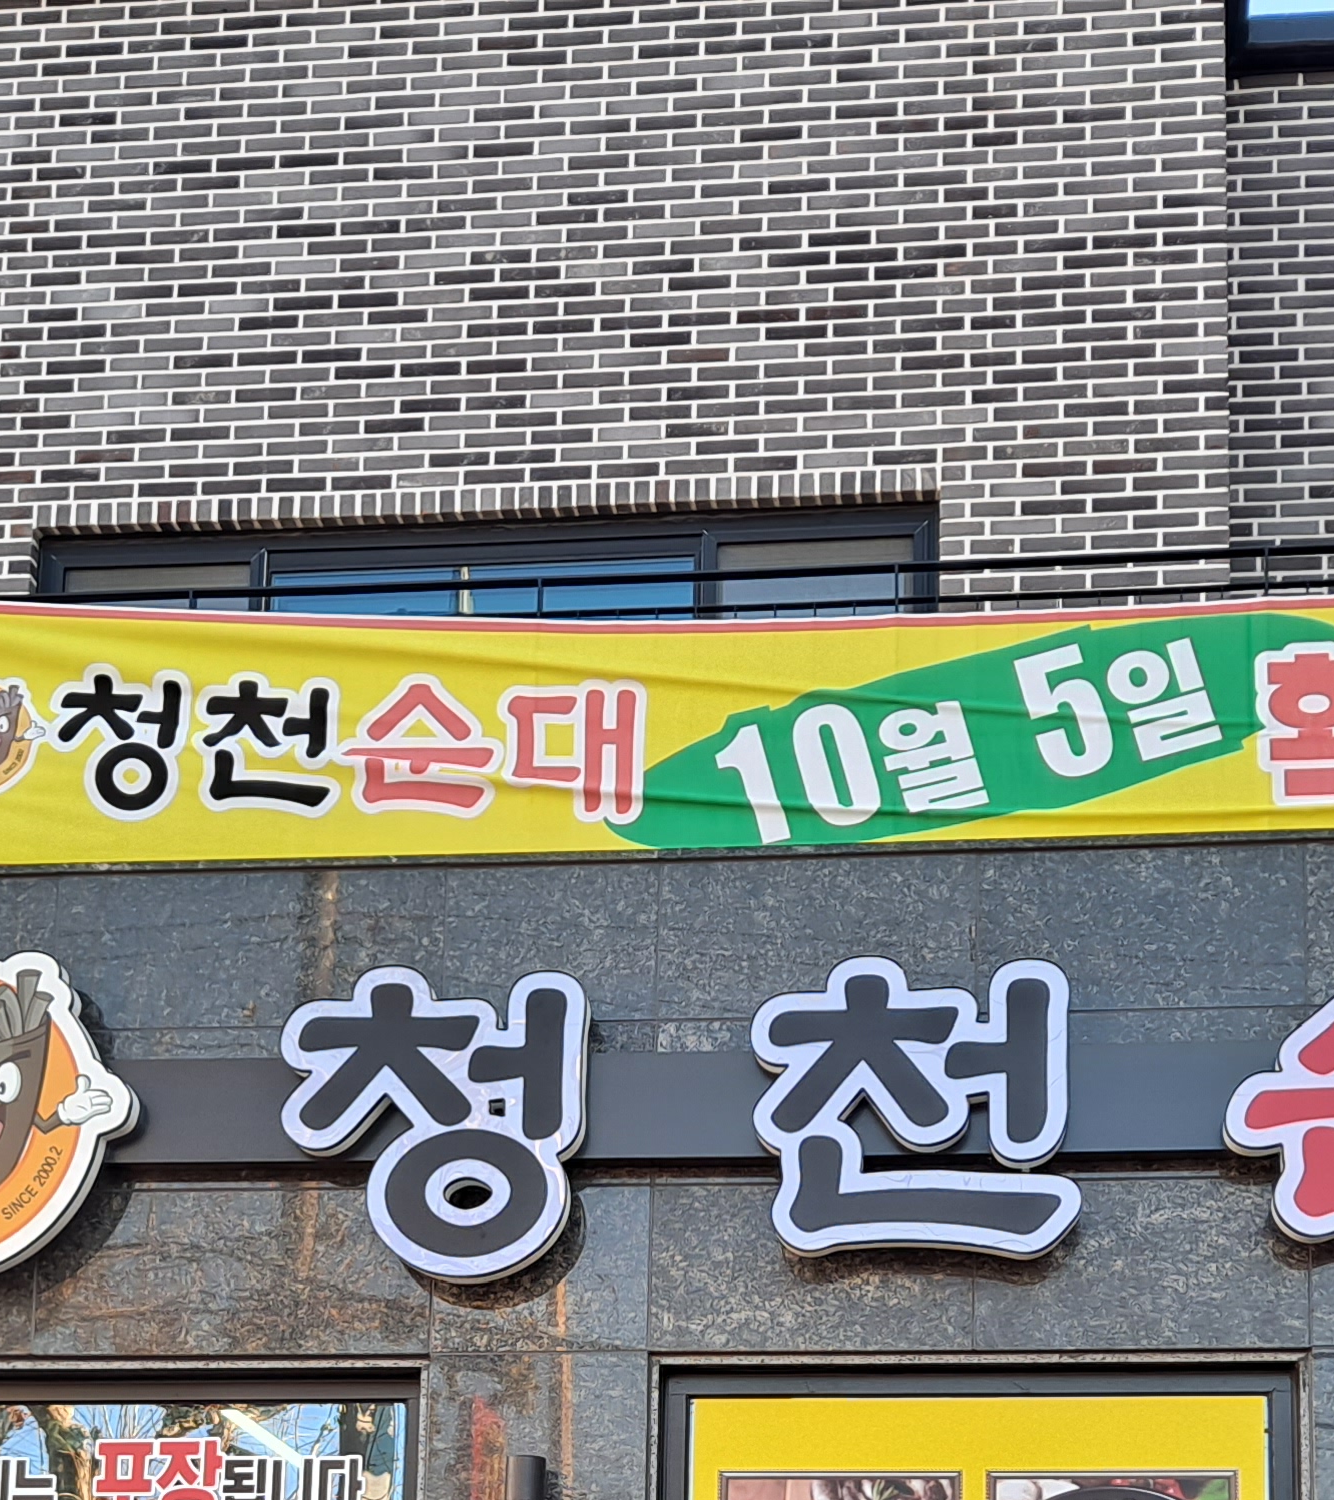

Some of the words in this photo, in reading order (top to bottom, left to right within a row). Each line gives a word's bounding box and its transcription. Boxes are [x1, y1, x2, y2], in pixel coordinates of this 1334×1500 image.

[55, 672, 638, 819] 청천순대
[716, 700, 988, 845] 10월
[1012, 638, 1221, 780] 5일
[1, 1186, 38, 1221] SINCE
[33, 1144, 64, 1191] 2000.2
